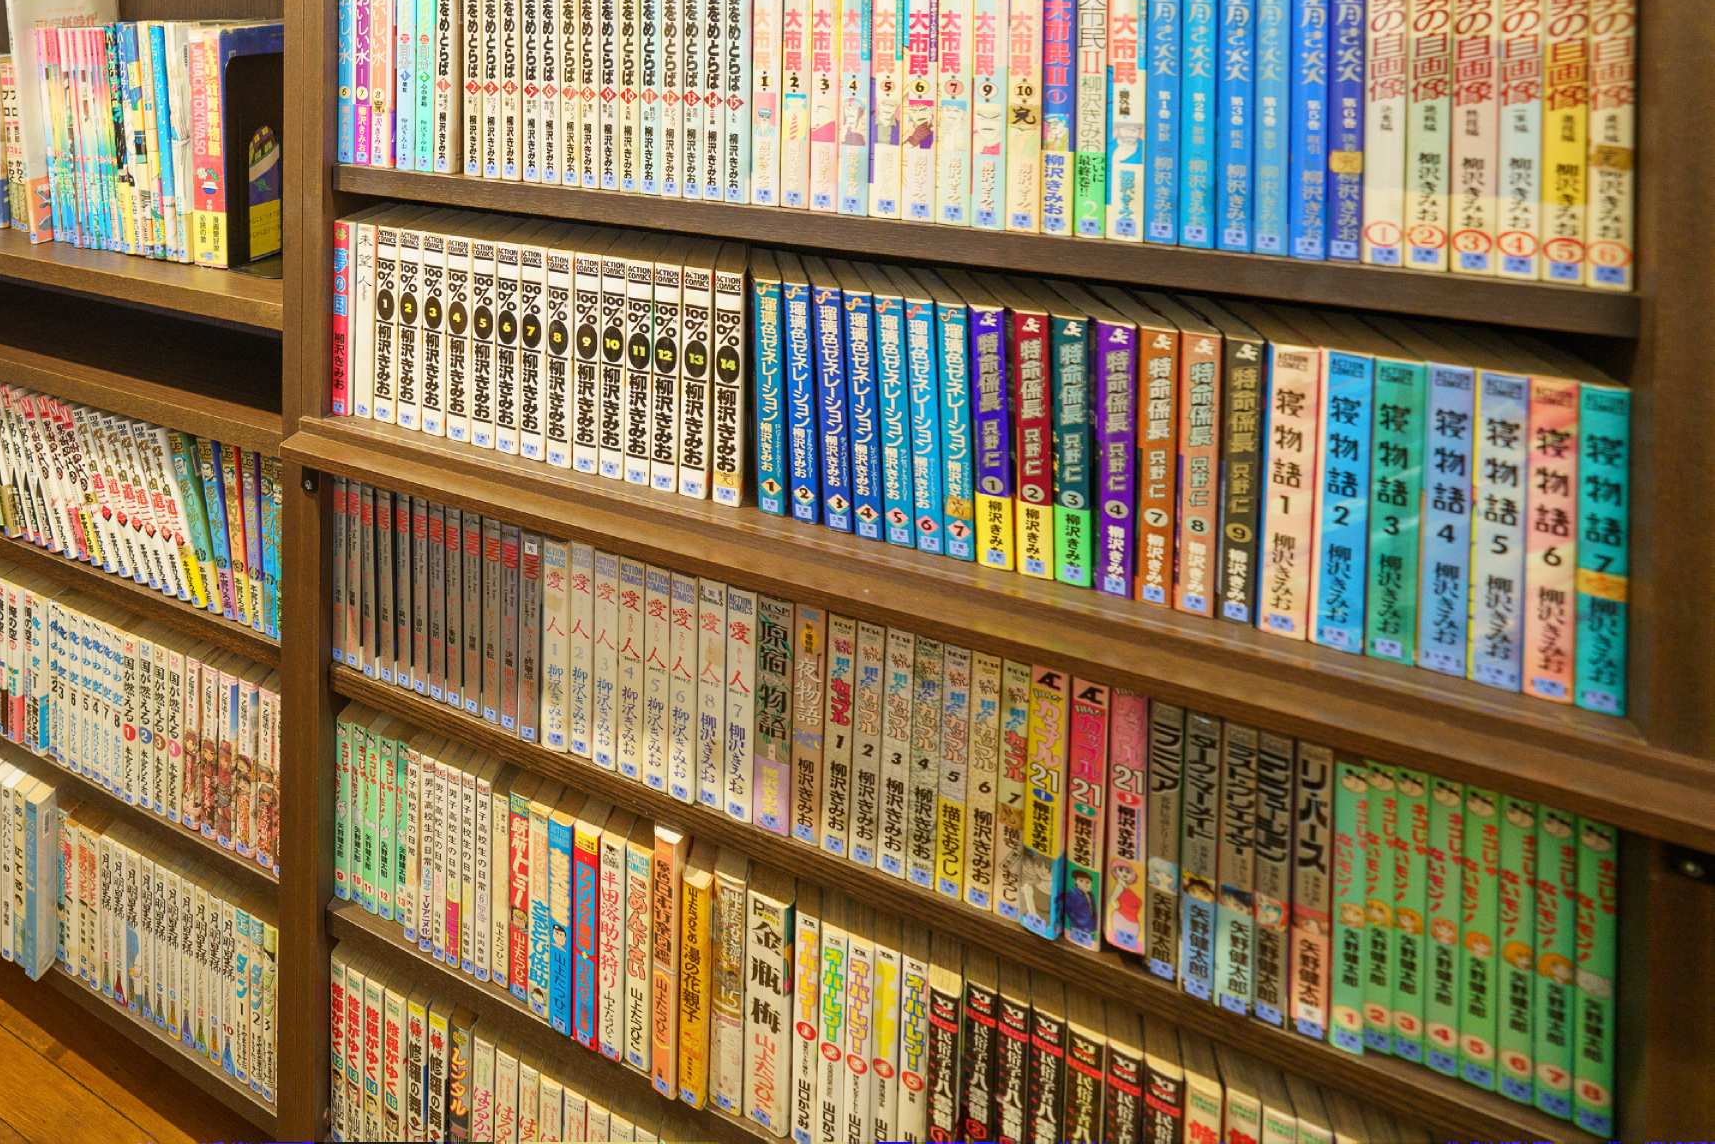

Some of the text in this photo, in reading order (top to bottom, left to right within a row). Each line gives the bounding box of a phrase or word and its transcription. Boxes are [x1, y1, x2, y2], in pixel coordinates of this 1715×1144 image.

[813, 9, 831, 73] 大市民
[843, 9, 862, 73] 大市民
[876, 9, 896, 74] 大市民
[908, 10, 929, 93] 大市民 6
[940, 9, 961, 75] 大市民
[974, 11, 995, 97] 大市民 9
[1009, 14, 1033, 97] 大市民 10
[528, 85, 535, 95] 5
[584, 89, 592, 98] 8
[604, 90, 612, 100] 9
[687, 93, 698, 103] 13
[729, 96, 741, 107] 15
[405, 303, 412, 313] 2
[452, 312, 461, 322] 4
[502, 321, 511, 332] 6
[549, 332, 566, 438] 8 柳沢きみお
[603, 338, 620, 447] 10 柳沢きみお
[721, 357, 736, 370] 14
[976, 331, 1003, 413] 特命係長
[1019, 338, 1046, 420] 特命係長
[1058, 341, 1084, 425] 特命係長
[1104, 349, 1131, 433] 特命係長
[577, 364, 594, 442] 柳沢きみお
[628, 345, 647, 455] 11 柳沢きみお
[654, 349, 673, 461] 12 柳沢きみお
[684, 352, 705, 466] 13 柳沢きみお
[717, 388, 737, 473] 柳沢きみお
[1272, 387, 1305, 515] 寝物語 1
[1327, 395, 1362, 526] 寝物語 2
[1376, 404, 1412, 536] 寝物語 3
[1432, 408, 1469, 543] 寝物語 4
[799, 489, 809, 500] 2
[861, 507, 873, 520] 4
[1483, 418, 1521, 555] 寝物語 5
[1534, 427, 1571, 567] 寝物語 6
[1583, 433, 1623, 547] 寝物語
[954, 524, 965, 537] 7
[729, 621, 750, 645] 愛
[124, 657, 135, 738] 国が燃える 1
[140, 659, 151, 726] 国が燃える
[155, 665, 165, 733] 国が燃える
[169, 671, 180, 739] 国が燃える
[796, 657, 822, 727] 夜物語
[835, 735, 844, 748] 1
[862, 744, 874, 757] 2
[891, 753, 903, 765] 3
[407, 768, 417, 857] 男子高校生の日常
[978, 780, 991, 793] 6
[1029, 764, 1059, 792] 21
[1069, 777, 1102, 807] 21
[1113, 765, 1146, 794] 21
[423, 777, 434, 867] 男子高校生の日常
[462, 792, 472, 884] 男子高校生の日常
[477, 799, 487, 892] 男子高校生の日常
[600, 870, 621, 989] 半田溶助女狩り
[222, 1023, 234, 1036] 10
